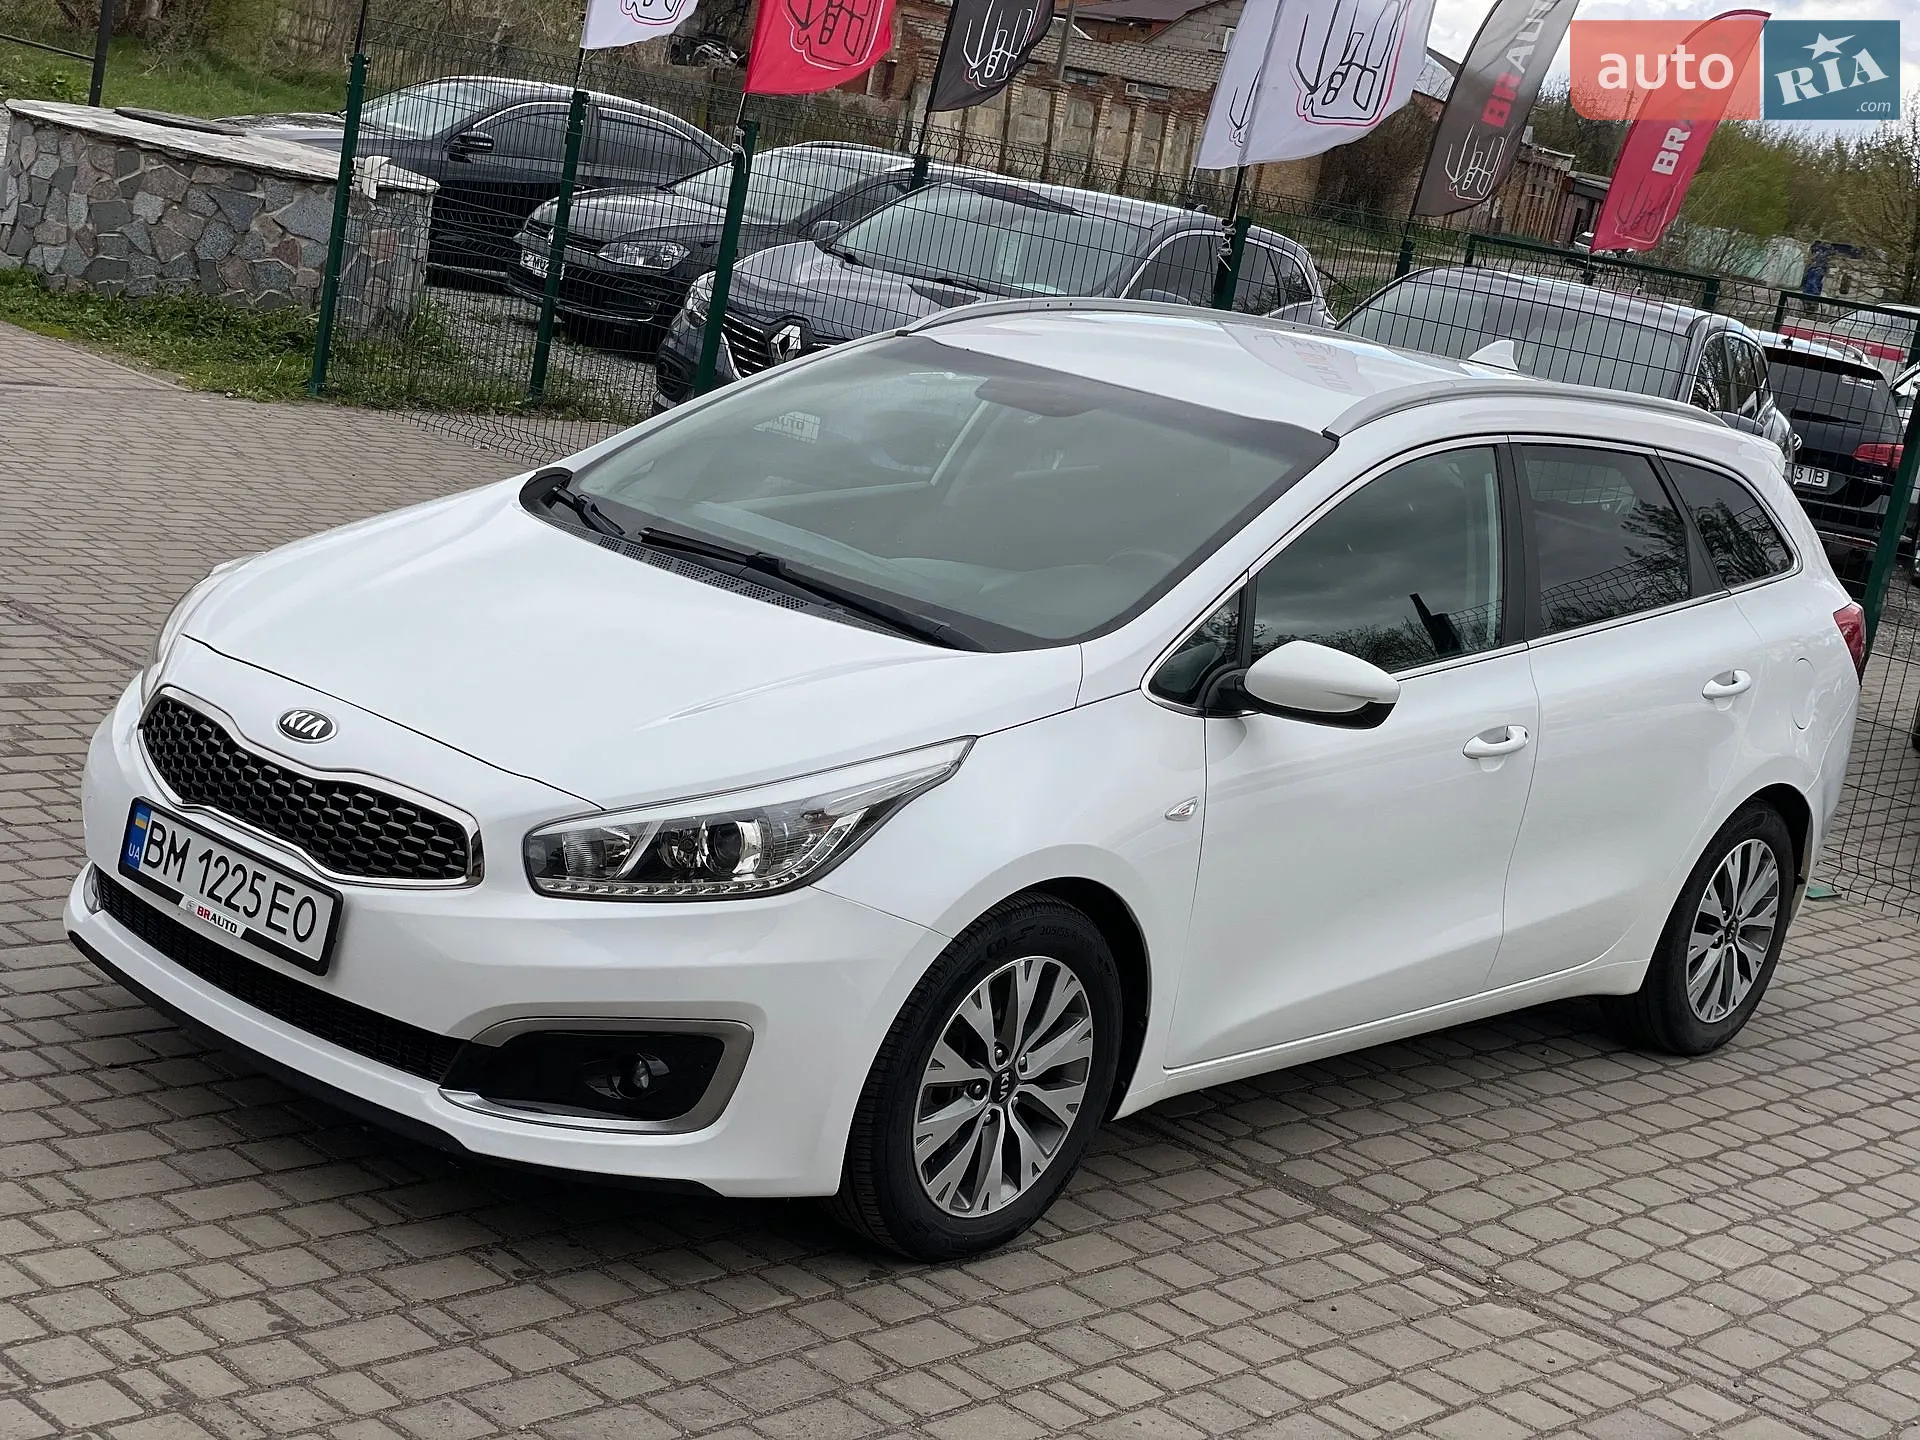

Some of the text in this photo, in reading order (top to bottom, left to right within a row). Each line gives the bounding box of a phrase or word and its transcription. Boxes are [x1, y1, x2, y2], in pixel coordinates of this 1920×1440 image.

[282, 710, 327, 738] KIA
[128, 844, 140, 861] UA
[143, 819, 317, 943] BM 1225 EO
[197, 905, 237, 934] BRAUTO
[999, 1071, 1010, 1102] KIA
